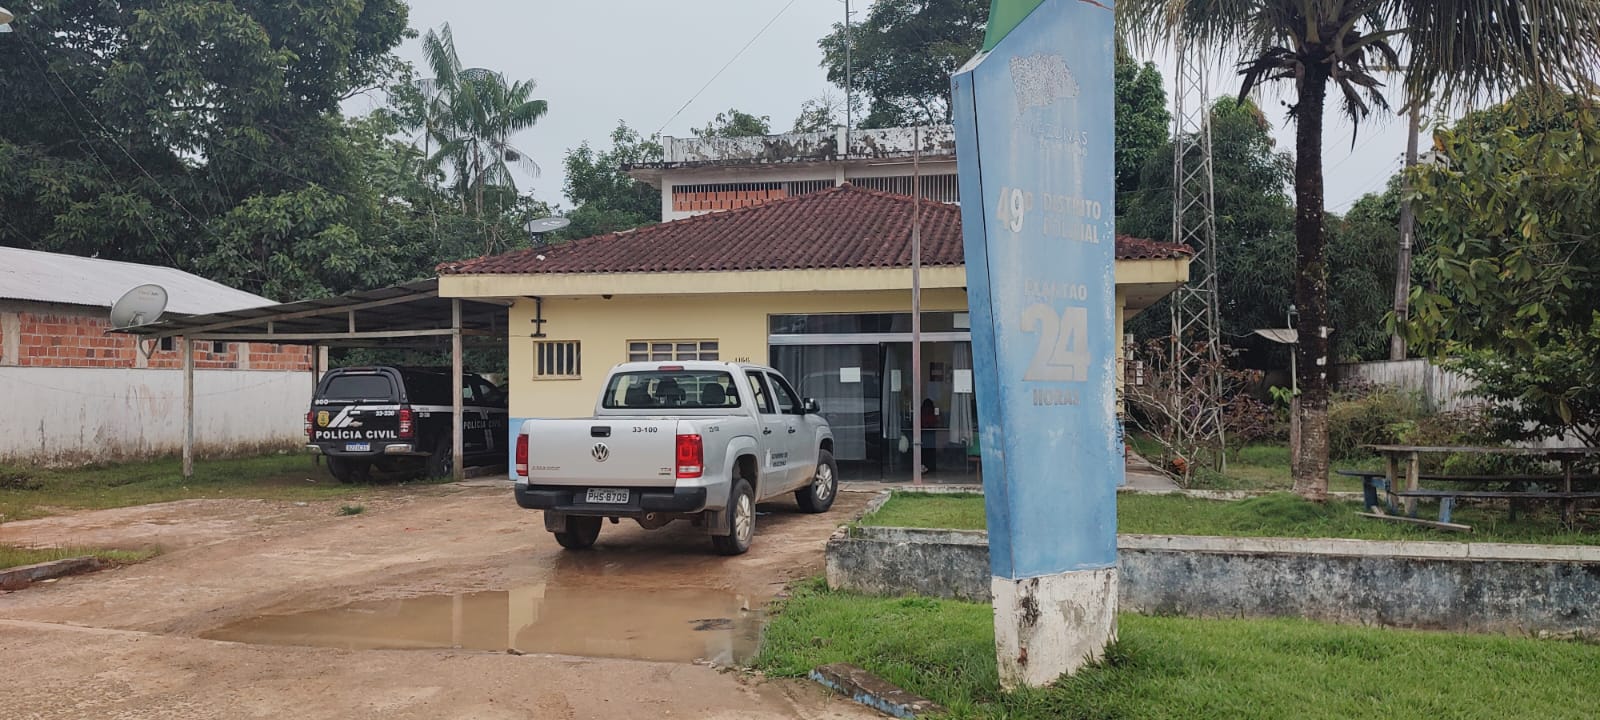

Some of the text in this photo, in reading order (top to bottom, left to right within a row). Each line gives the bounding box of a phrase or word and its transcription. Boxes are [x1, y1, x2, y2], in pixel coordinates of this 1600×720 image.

[1043, 216, 1100, 244] POLIAL
[1019, 303, 1092, 382] 24
[315, 428, 398, 439] POLÍCIA CIVIL
[588, 492, 628, 502] PHS-8709
